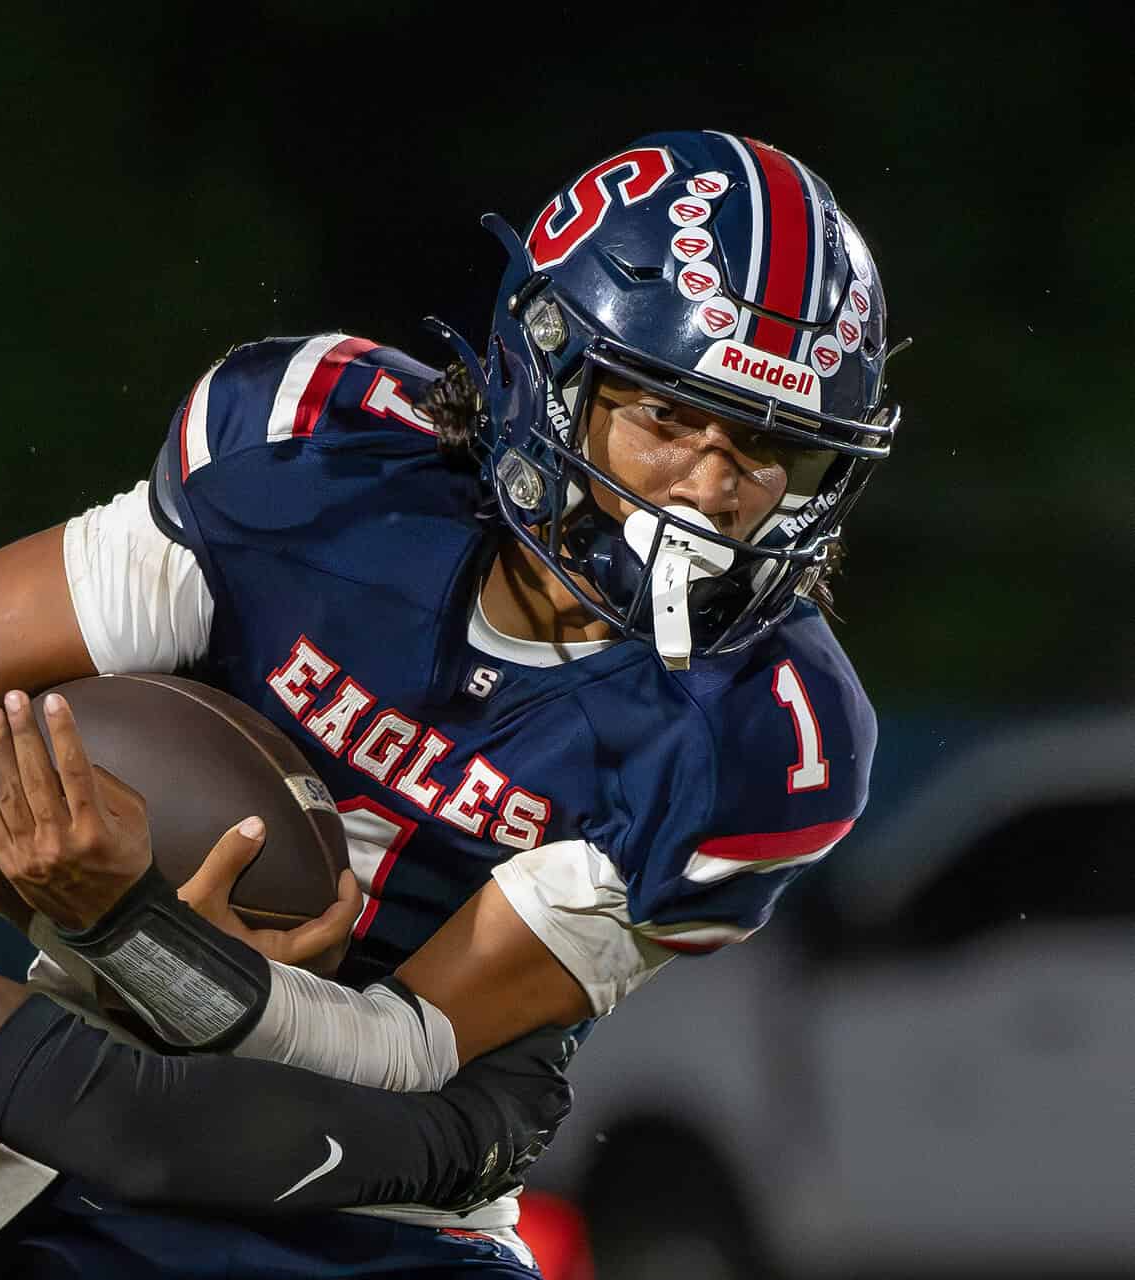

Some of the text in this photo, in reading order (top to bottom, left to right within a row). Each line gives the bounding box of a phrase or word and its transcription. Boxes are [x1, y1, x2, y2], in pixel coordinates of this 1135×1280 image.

[525, 147, 674, 272] S
[721, 346, 814, 396] Riddell
[266, 633, 552, 852] EAGLES
[468, 667, 498, 698] S
[771, 658, 830, 794] 1
